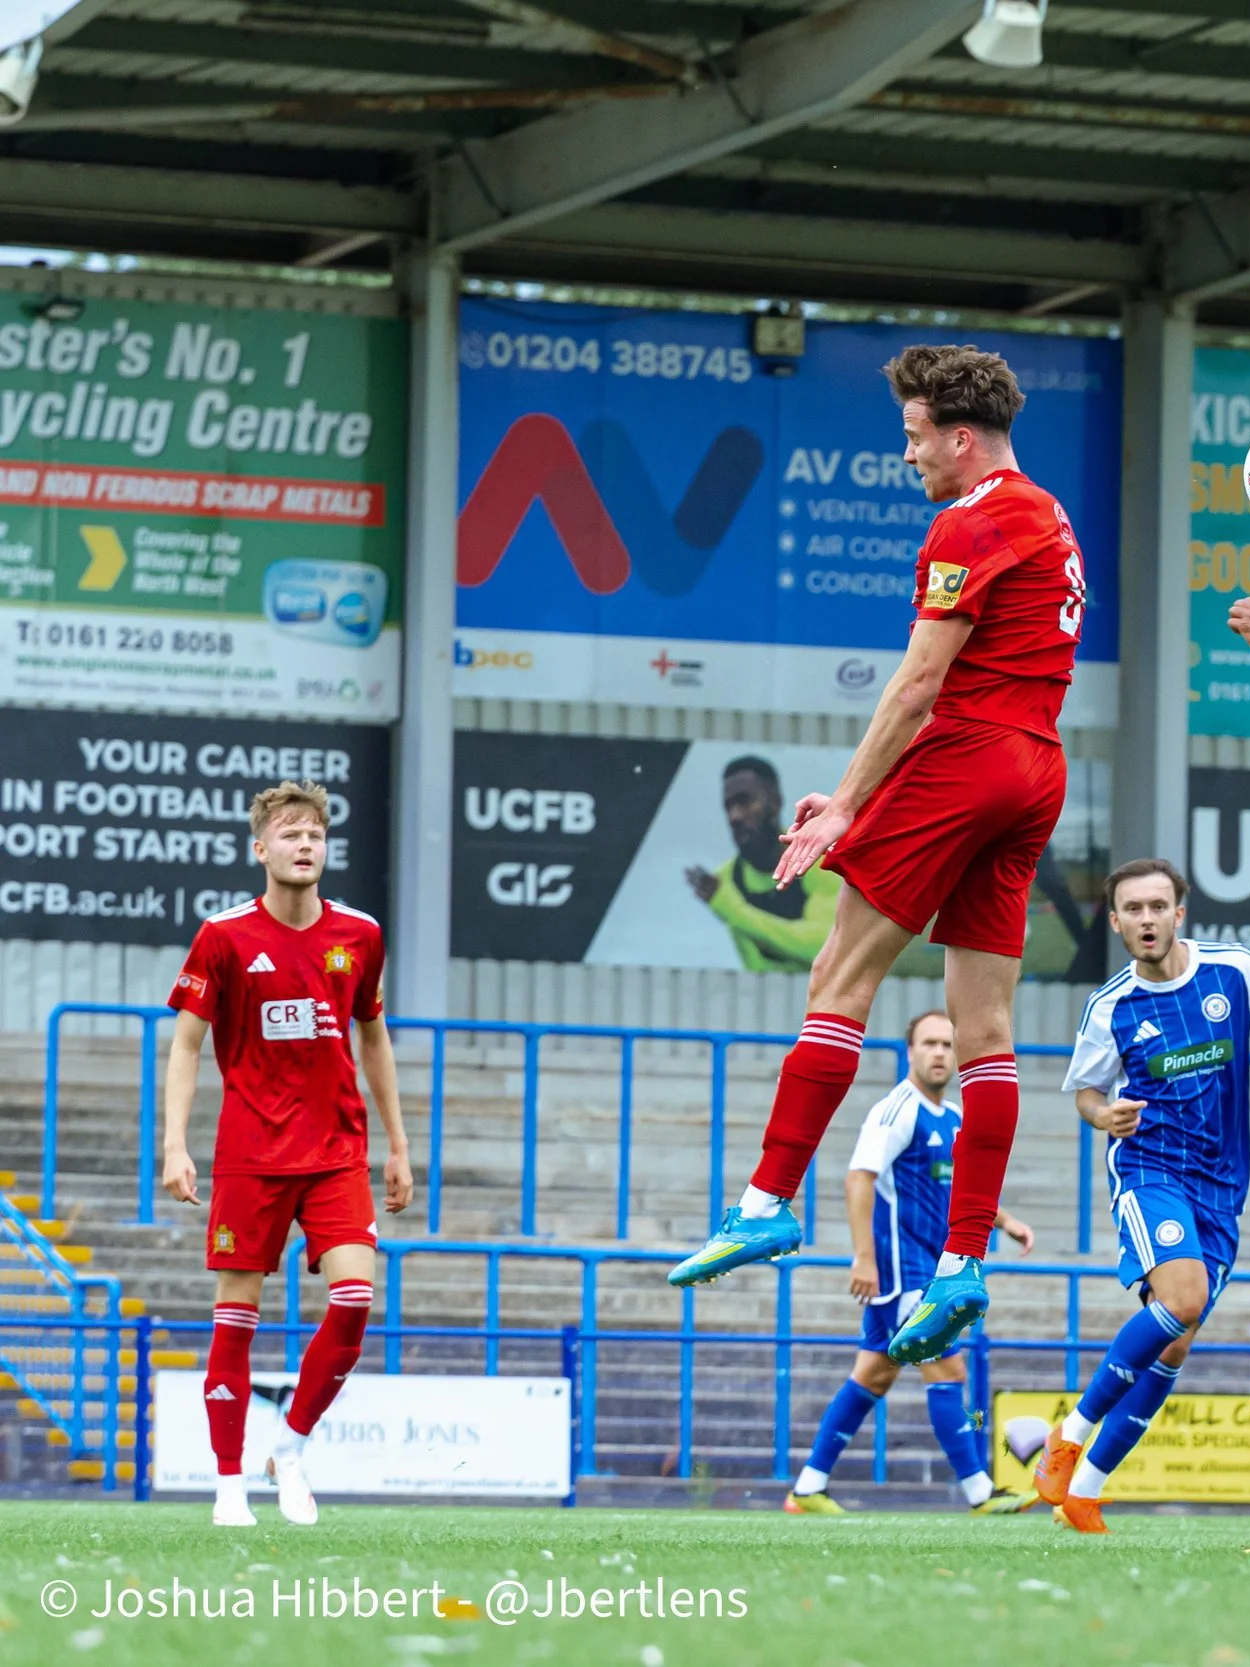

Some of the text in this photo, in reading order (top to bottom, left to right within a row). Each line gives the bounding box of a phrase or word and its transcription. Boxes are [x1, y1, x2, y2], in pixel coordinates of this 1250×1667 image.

[0, 317, 311, 388] ster's No. 1
[487, 332, 752, 383] 01204 388745
[0, 380, 373, 458] ycling Centre
[783, 448, 842, 485] AV
[43, 472, 91, 499] NON
[94, 474, 198, 506] FERROUS
[203, 480, 278, 513] SCRAP
[281, 486, 371, 518] METALS
[808, 534, 844, 559] AIR
[928, 563, 968, 594] bd
[47, 623, 107, 648] 0161
[117, 626, 163, 651] 220
[171, 630, 234, 657] 8058
[79, 737, 350, 783] YOUR CAREER
[1, 779, 251, 821] IN FOOTBALL
[464, 786, 597, 834] UCFB
[93, 827, 237, 867] STARTS
[486, 862, 575, 908] GIS
[266, 1005, 300, 1024] CR
[1163, 1045, 1224, 1072] Pinnacle
[403, 1416, 480, 1445] JONES
[1160, 1401, 1223, 1426] MILL
